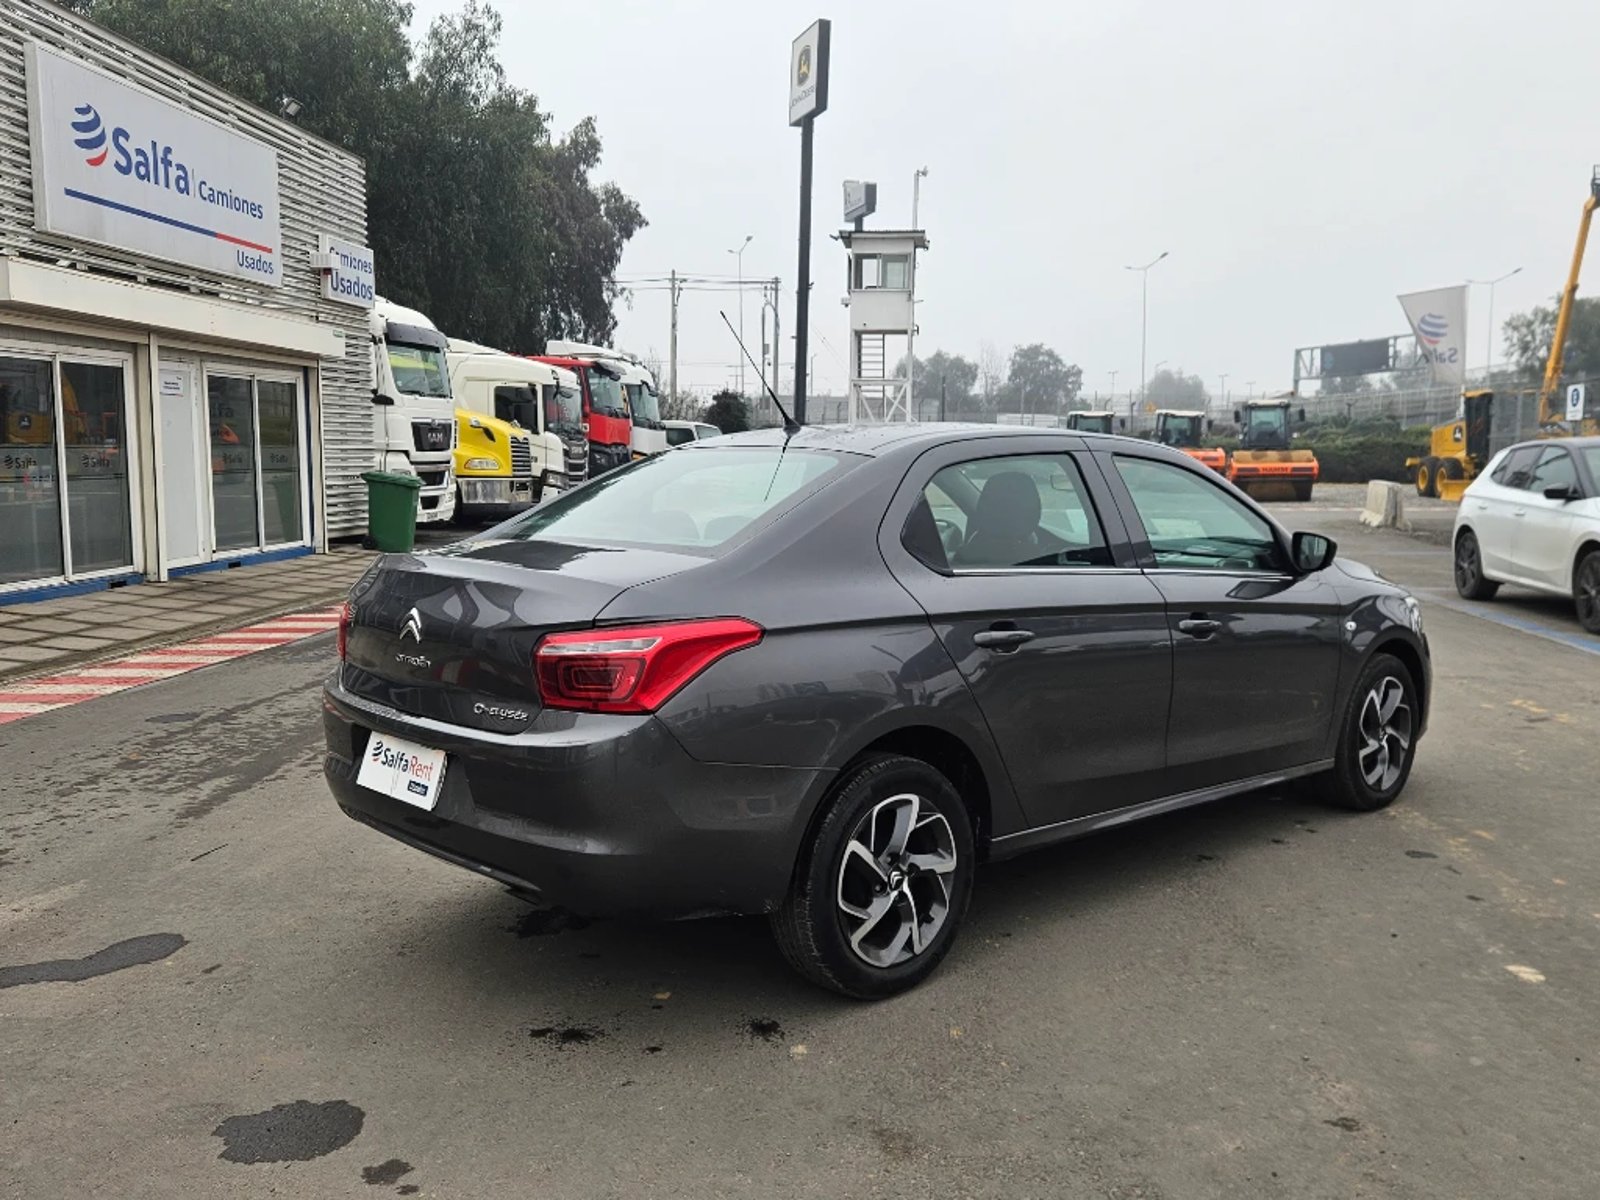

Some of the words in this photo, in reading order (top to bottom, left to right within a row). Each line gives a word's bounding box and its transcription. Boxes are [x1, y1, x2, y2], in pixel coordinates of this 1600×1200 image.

[112, 126, 190, 197] Salfa
[199, 179, 264, 220] Camiones
[236, 248, 275, 275] Usados
[330, 269, 373, 300] Usados
